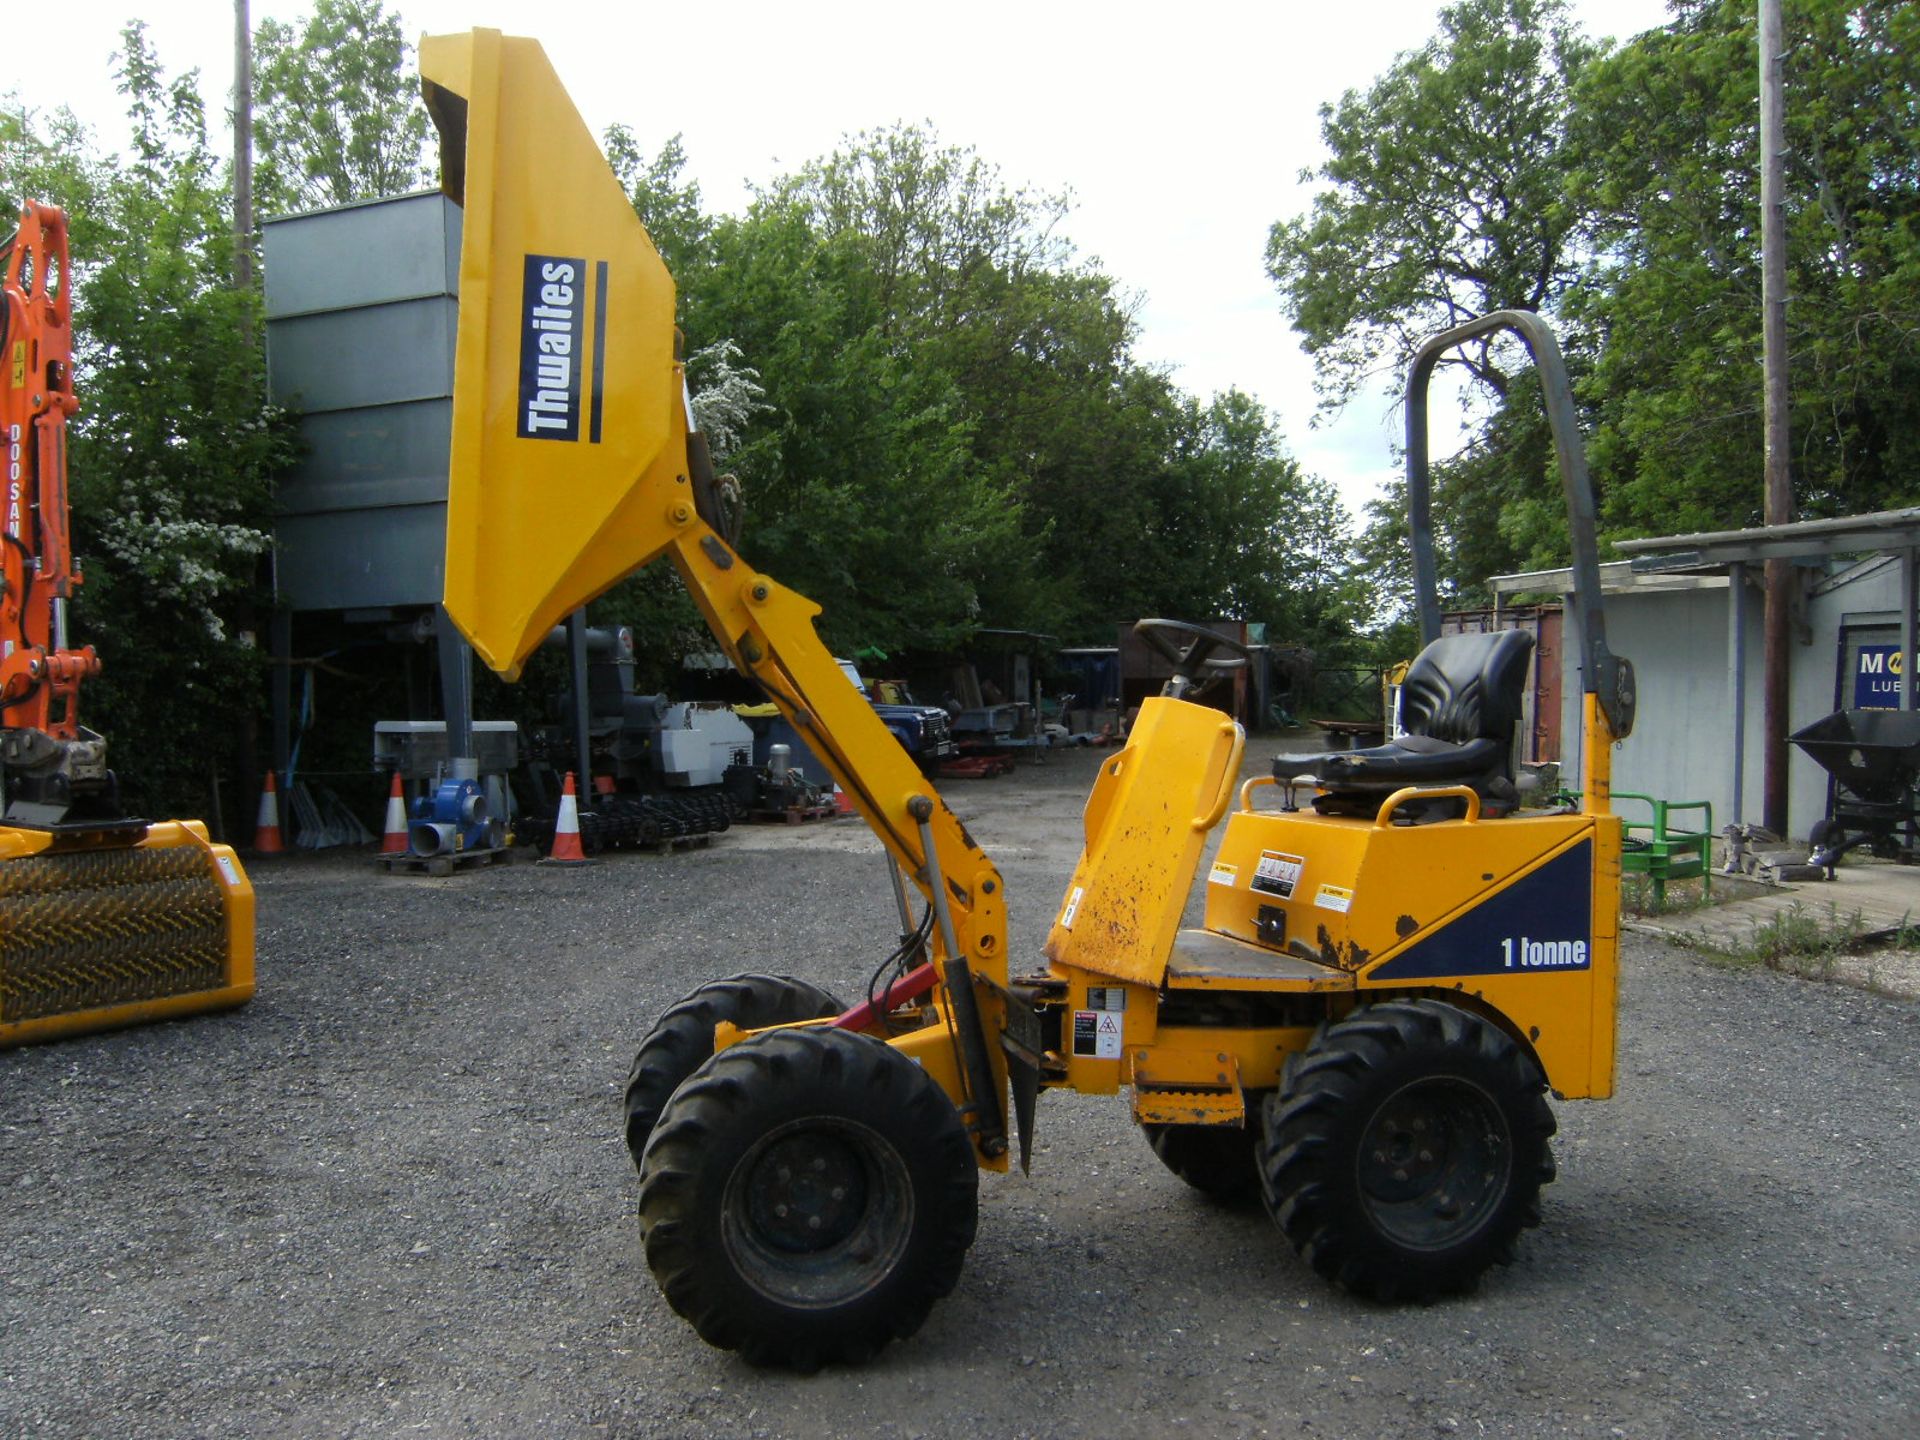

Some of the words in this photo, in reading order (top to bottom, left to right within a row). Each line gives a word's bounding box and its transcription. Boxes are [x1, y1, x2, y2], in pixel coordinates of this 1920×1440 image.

[527, 262, 575, 433] Thwaites
[9, 424, 21, 539] DOOSAN
[1501, 937, 1512, 967] 1
[1521, 936, 1586, 966] tonne
